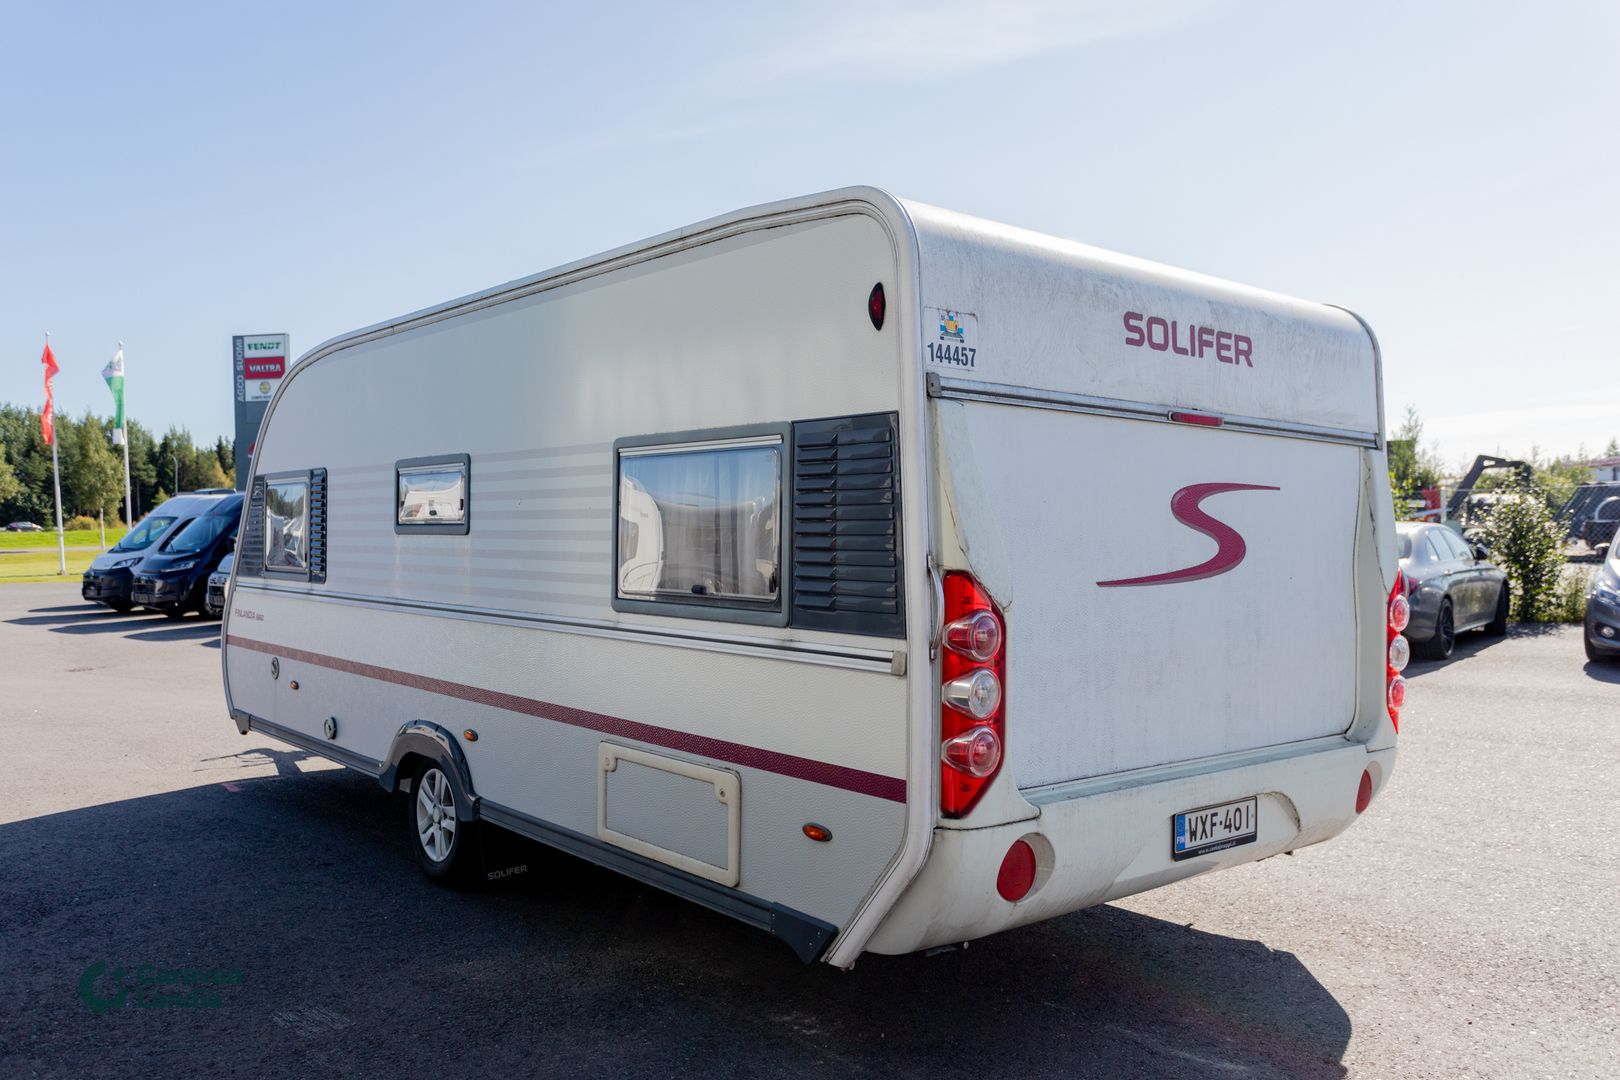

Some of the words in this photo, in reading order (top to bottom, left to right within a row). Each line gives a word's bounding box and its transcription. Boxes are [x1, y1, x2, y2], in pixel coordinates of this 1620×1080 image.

[247, 342, 281, 351] FENDT
[1123, 311, 1253, 368] SOLIFER
[236, 338, 244, 371] SUOMI
[927, 342, 976, 367] 144457
[248, 363, 282, 373] VALTRA
[236, 375, 244, 402] AGCO
[1188, 805, 1249, 842] WXF-401
[487, 865, 528, 880] SOLIFER
